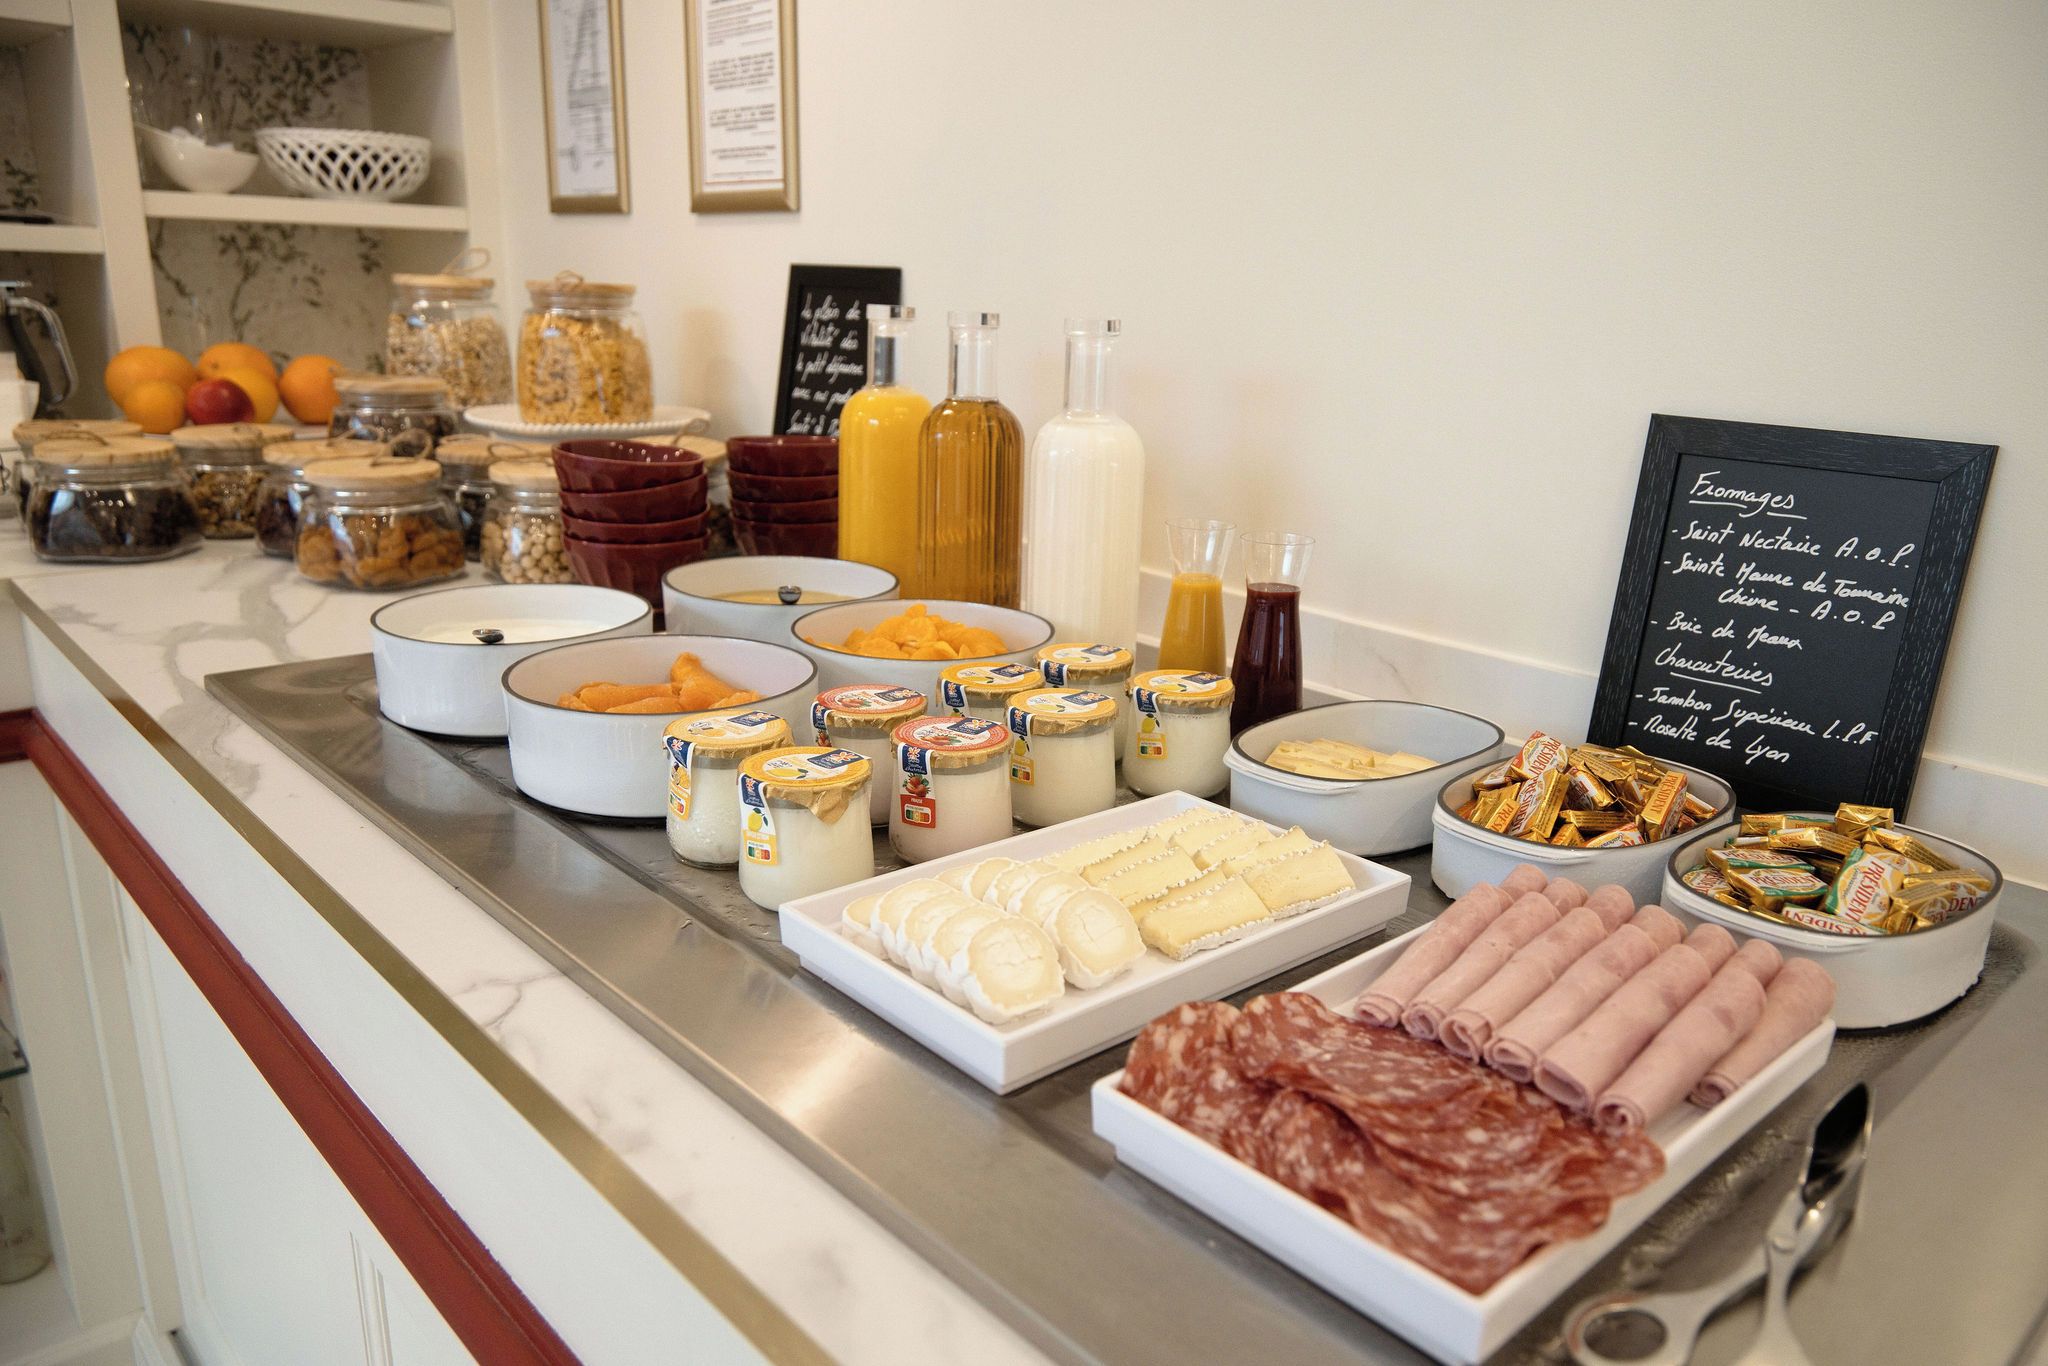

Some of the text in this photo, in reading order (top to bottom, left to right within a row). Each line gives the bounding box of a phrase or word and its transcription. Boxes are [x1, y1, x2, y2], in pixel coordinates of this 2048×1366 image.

[1689, 471, 1795, 518] Fromages
[1739, 526, 1821, 556] Nectaire
[1735, 562, 1794, 586] Maure
[1802, 571, 1827, 593] de
[1666, 611, 1702, 634] Brie
[1711, 619, 1735, 638] de
[1746, 625, 1803, 650] Meaux
[1654, 642, 1773, 687] Charcuteries
[1647, 687, 1712, 712] Jambon
[1643, 714, 1699, 742] Rosette
[1705, 728, 1732, 750] de
[1744, 734, 1790, 765] Lyon
